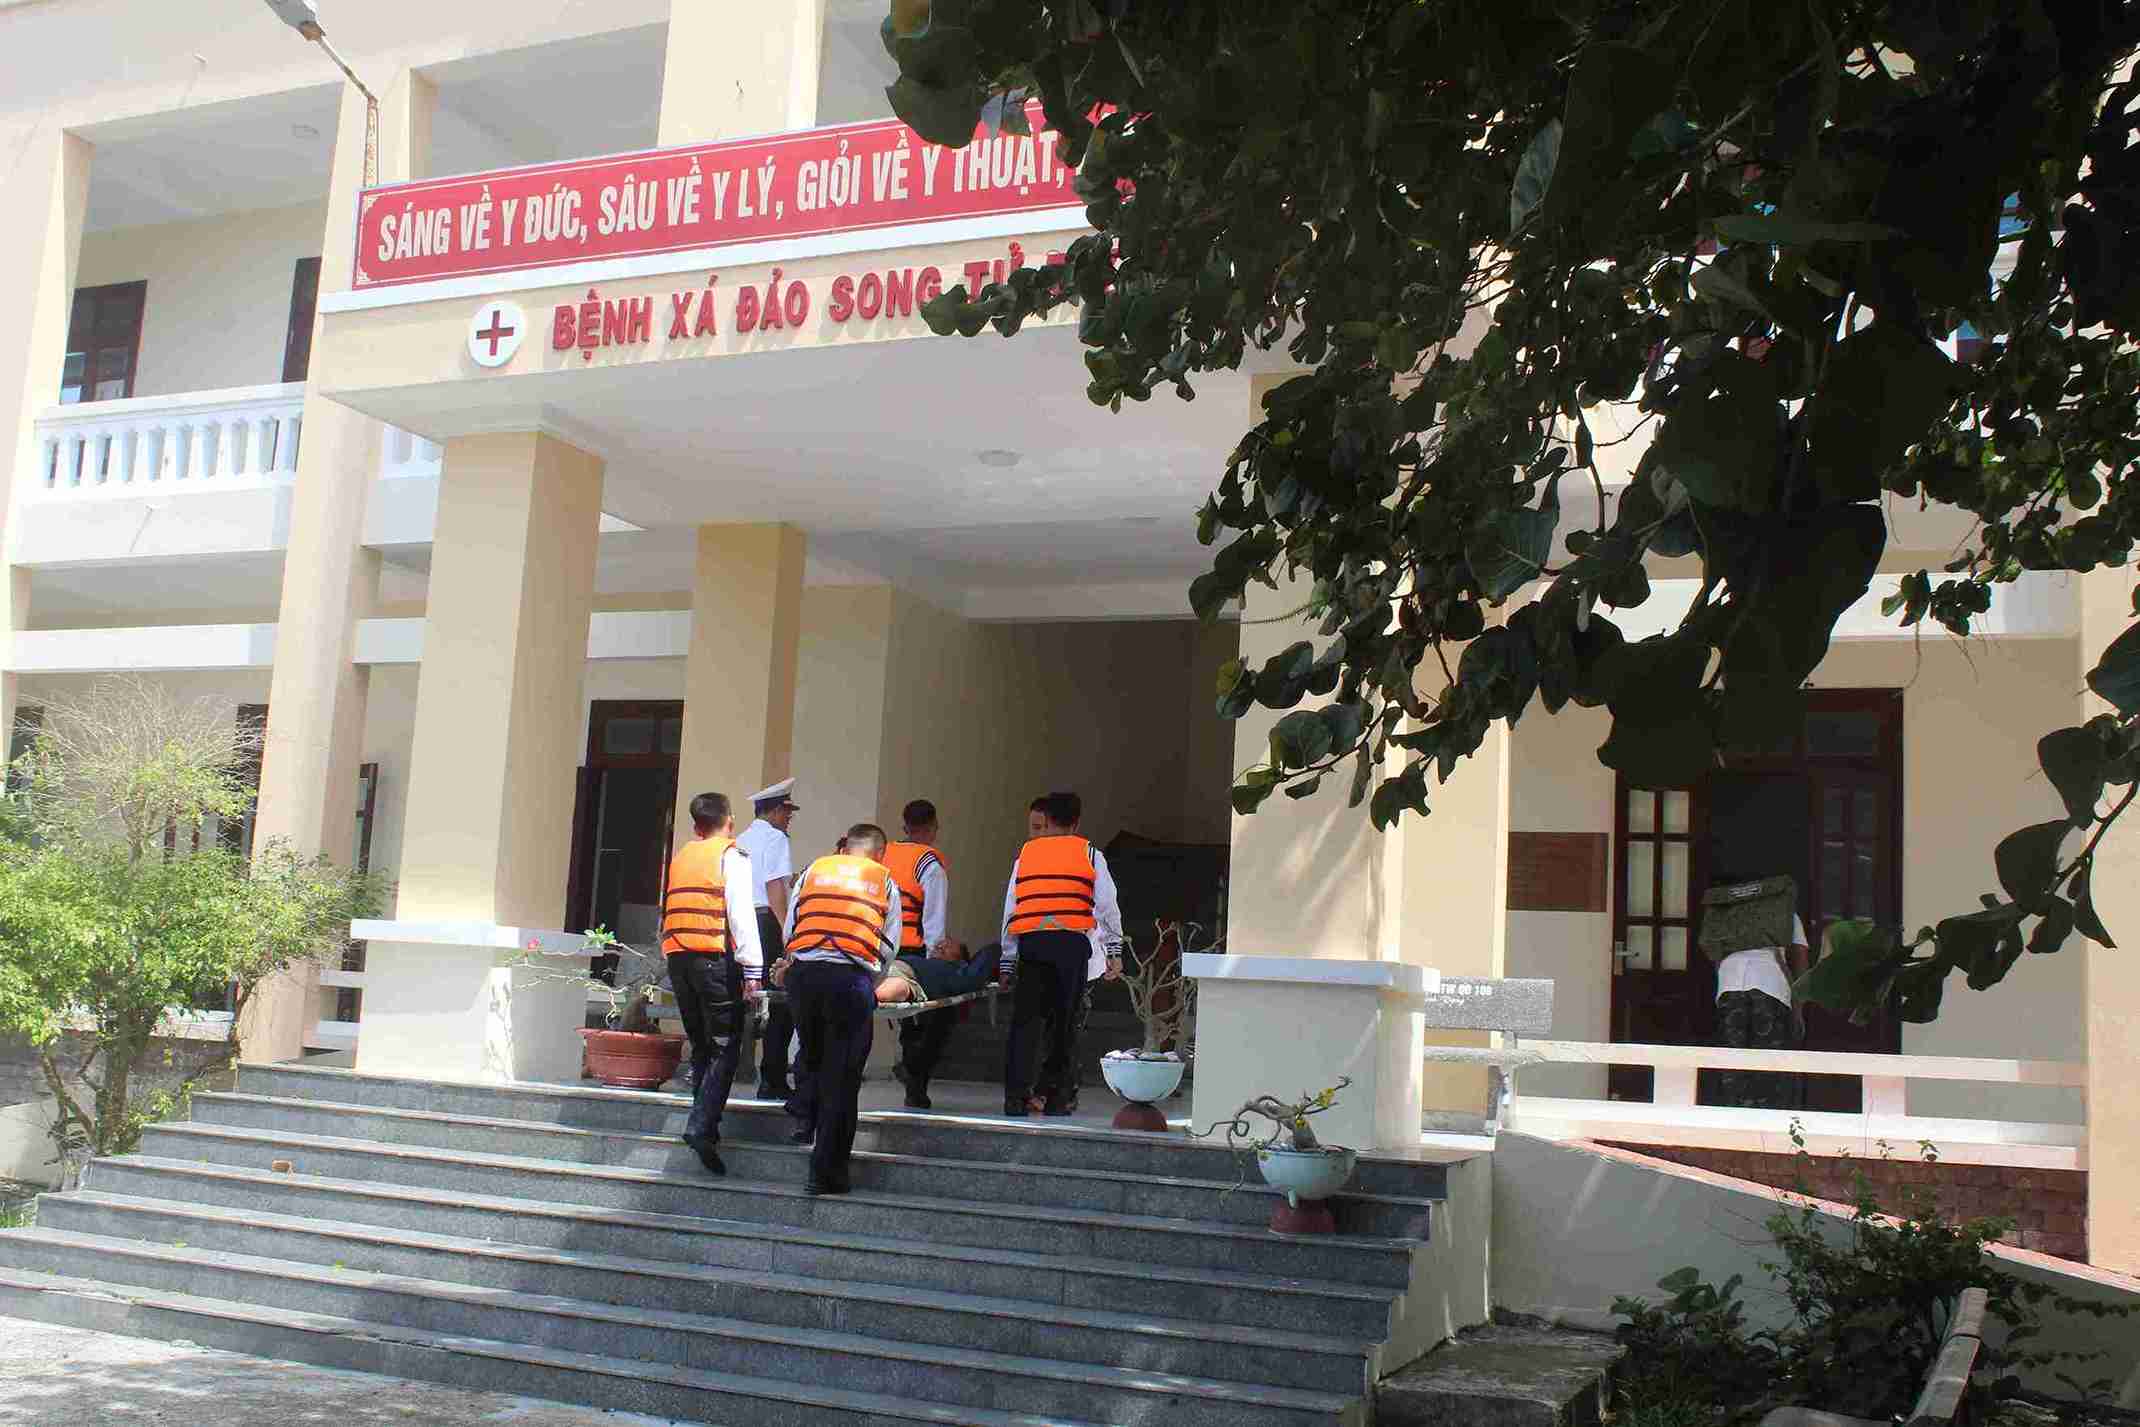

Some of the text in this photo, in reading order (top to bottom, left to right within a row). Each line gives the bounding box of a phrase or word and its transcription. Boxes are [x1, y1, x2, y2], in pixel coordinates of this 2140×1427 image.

[378, 202, 451, 262] SÁNG
[460, 185, 493, 250] VỀ
[502, 198, 519, 246] Y
[524, 183, 587, 244] ĐỨC,
[598, 174, 658, 235] SÂU
[667, 156, 702, 226] VỀ
[712, 171, 730, 220] Y
[738, 155, 784, 221] LÝ,
[797, 139, 862, 212] GIỎI
[872, 129, 911, 202] VỀ
[922, 144, 942, 196] Y
[552, 288, 653, 360] BỆNH
[669, 274, 718, 339] XÁ
[736, 267, 810, 333] ĐẢO
[829, 266, 942, 322] SONG
